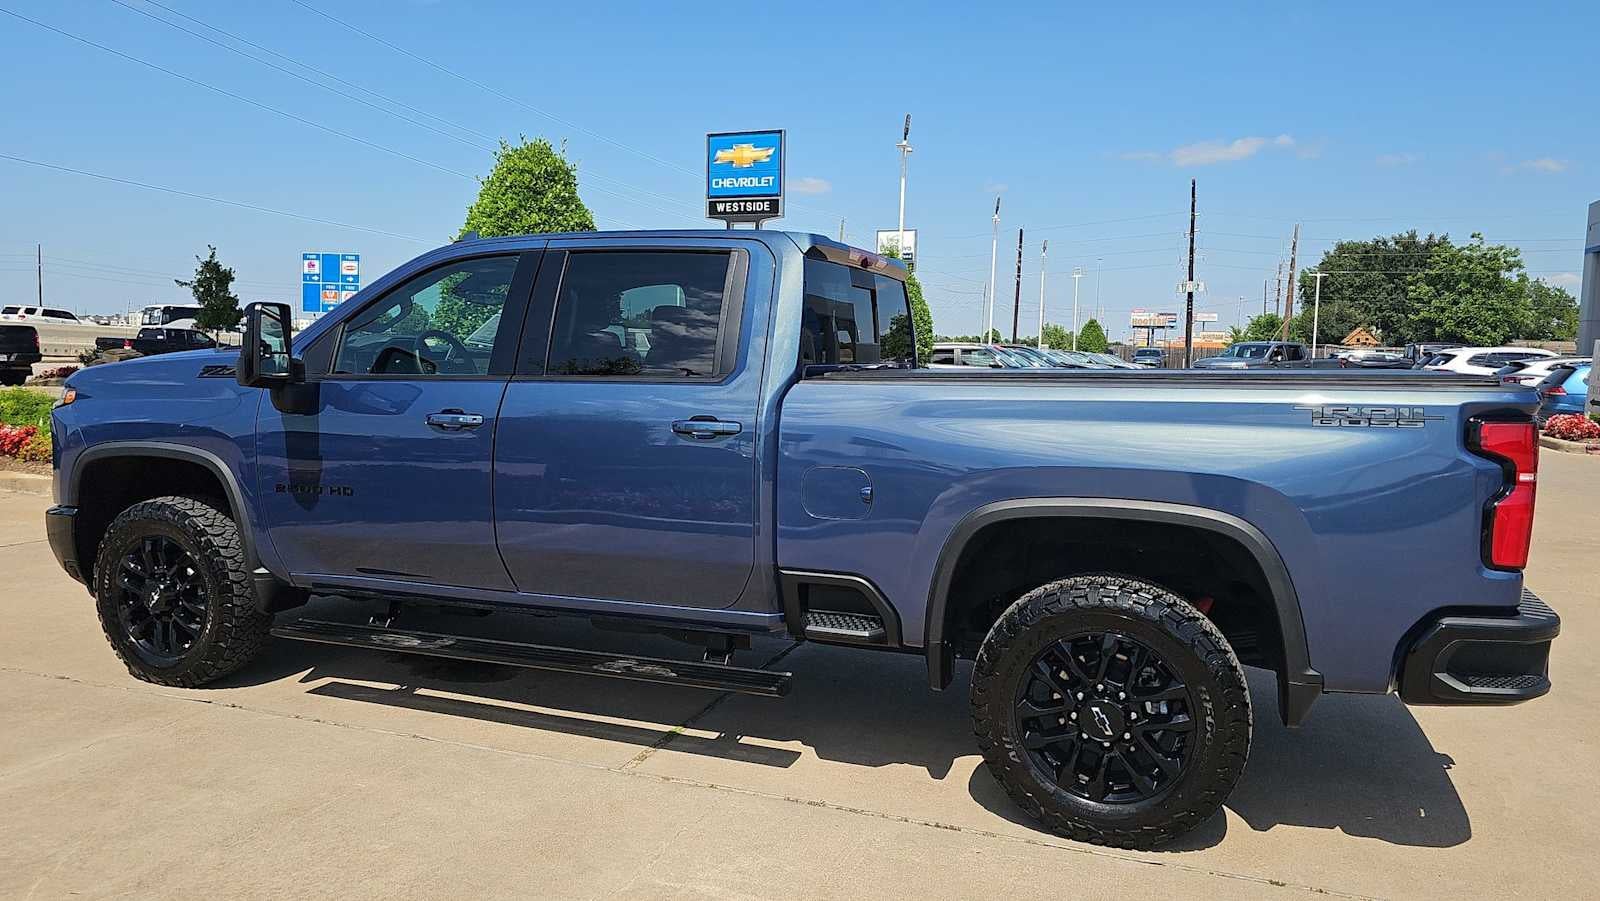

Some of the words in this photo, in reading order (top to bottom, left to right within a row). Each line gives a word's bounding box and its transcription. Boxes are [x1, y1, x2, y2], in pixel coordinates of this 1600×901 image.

[712, 176, 775, 188] CHEVROLET
[716, 201, 771, 213] WESTSIDE
[1294, 406, 1444, 420] TRAIL
[1312, 418, 1425, 428] BOSS
